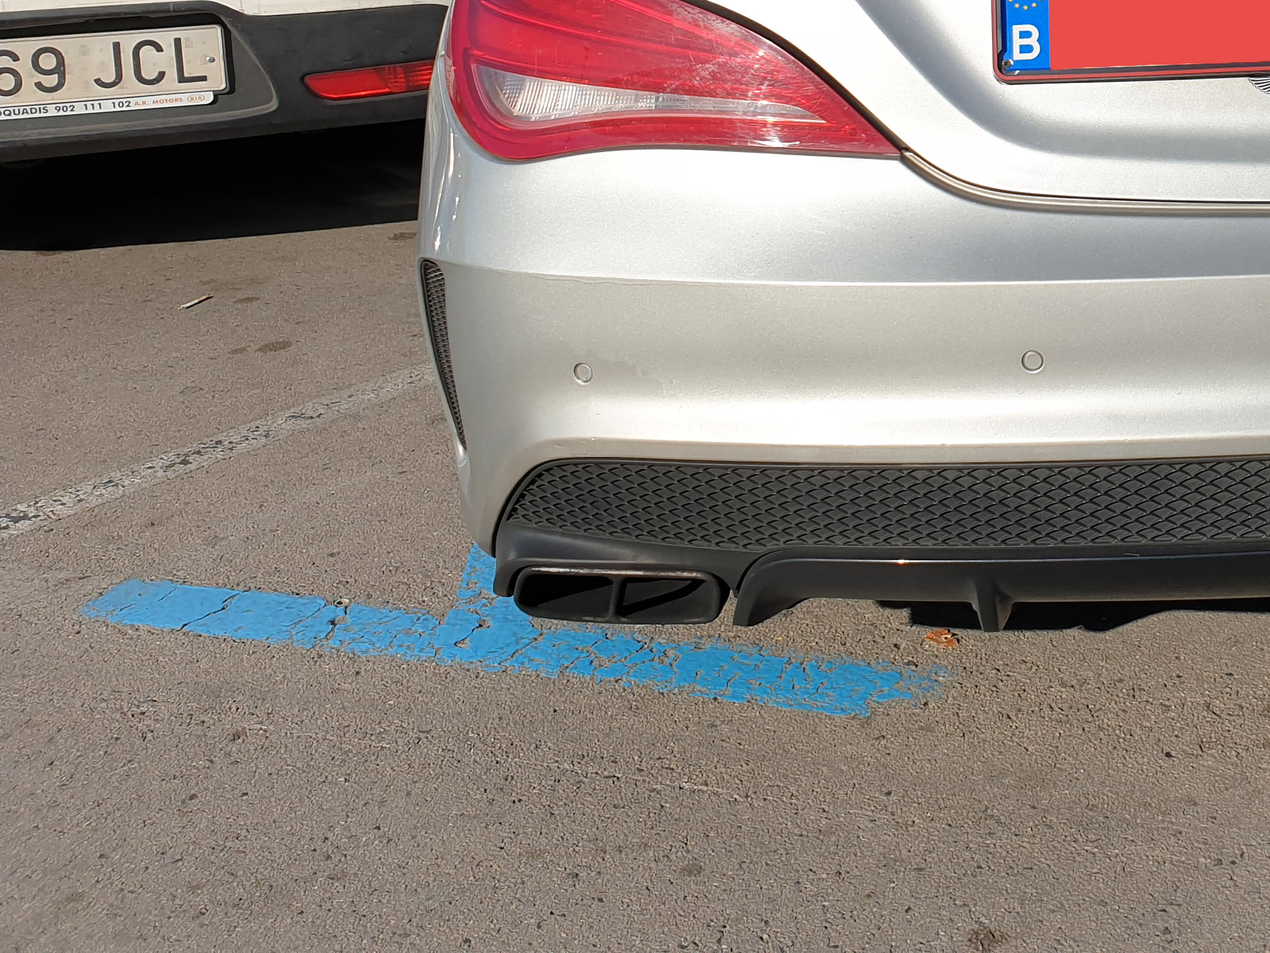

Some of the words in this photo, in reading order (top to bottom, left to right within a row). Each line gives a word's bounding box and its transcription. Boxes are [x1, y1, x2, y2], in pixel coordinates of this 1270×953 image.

[1012, 24, 1041, 61] B
[93, 37, 208, 89] JCL
[54, 104, 76, 113] 902
[83, 102, 102, 111] 111
[111, 100, 132, 109] 102
[152, 97, 184, 105] MOTORS
